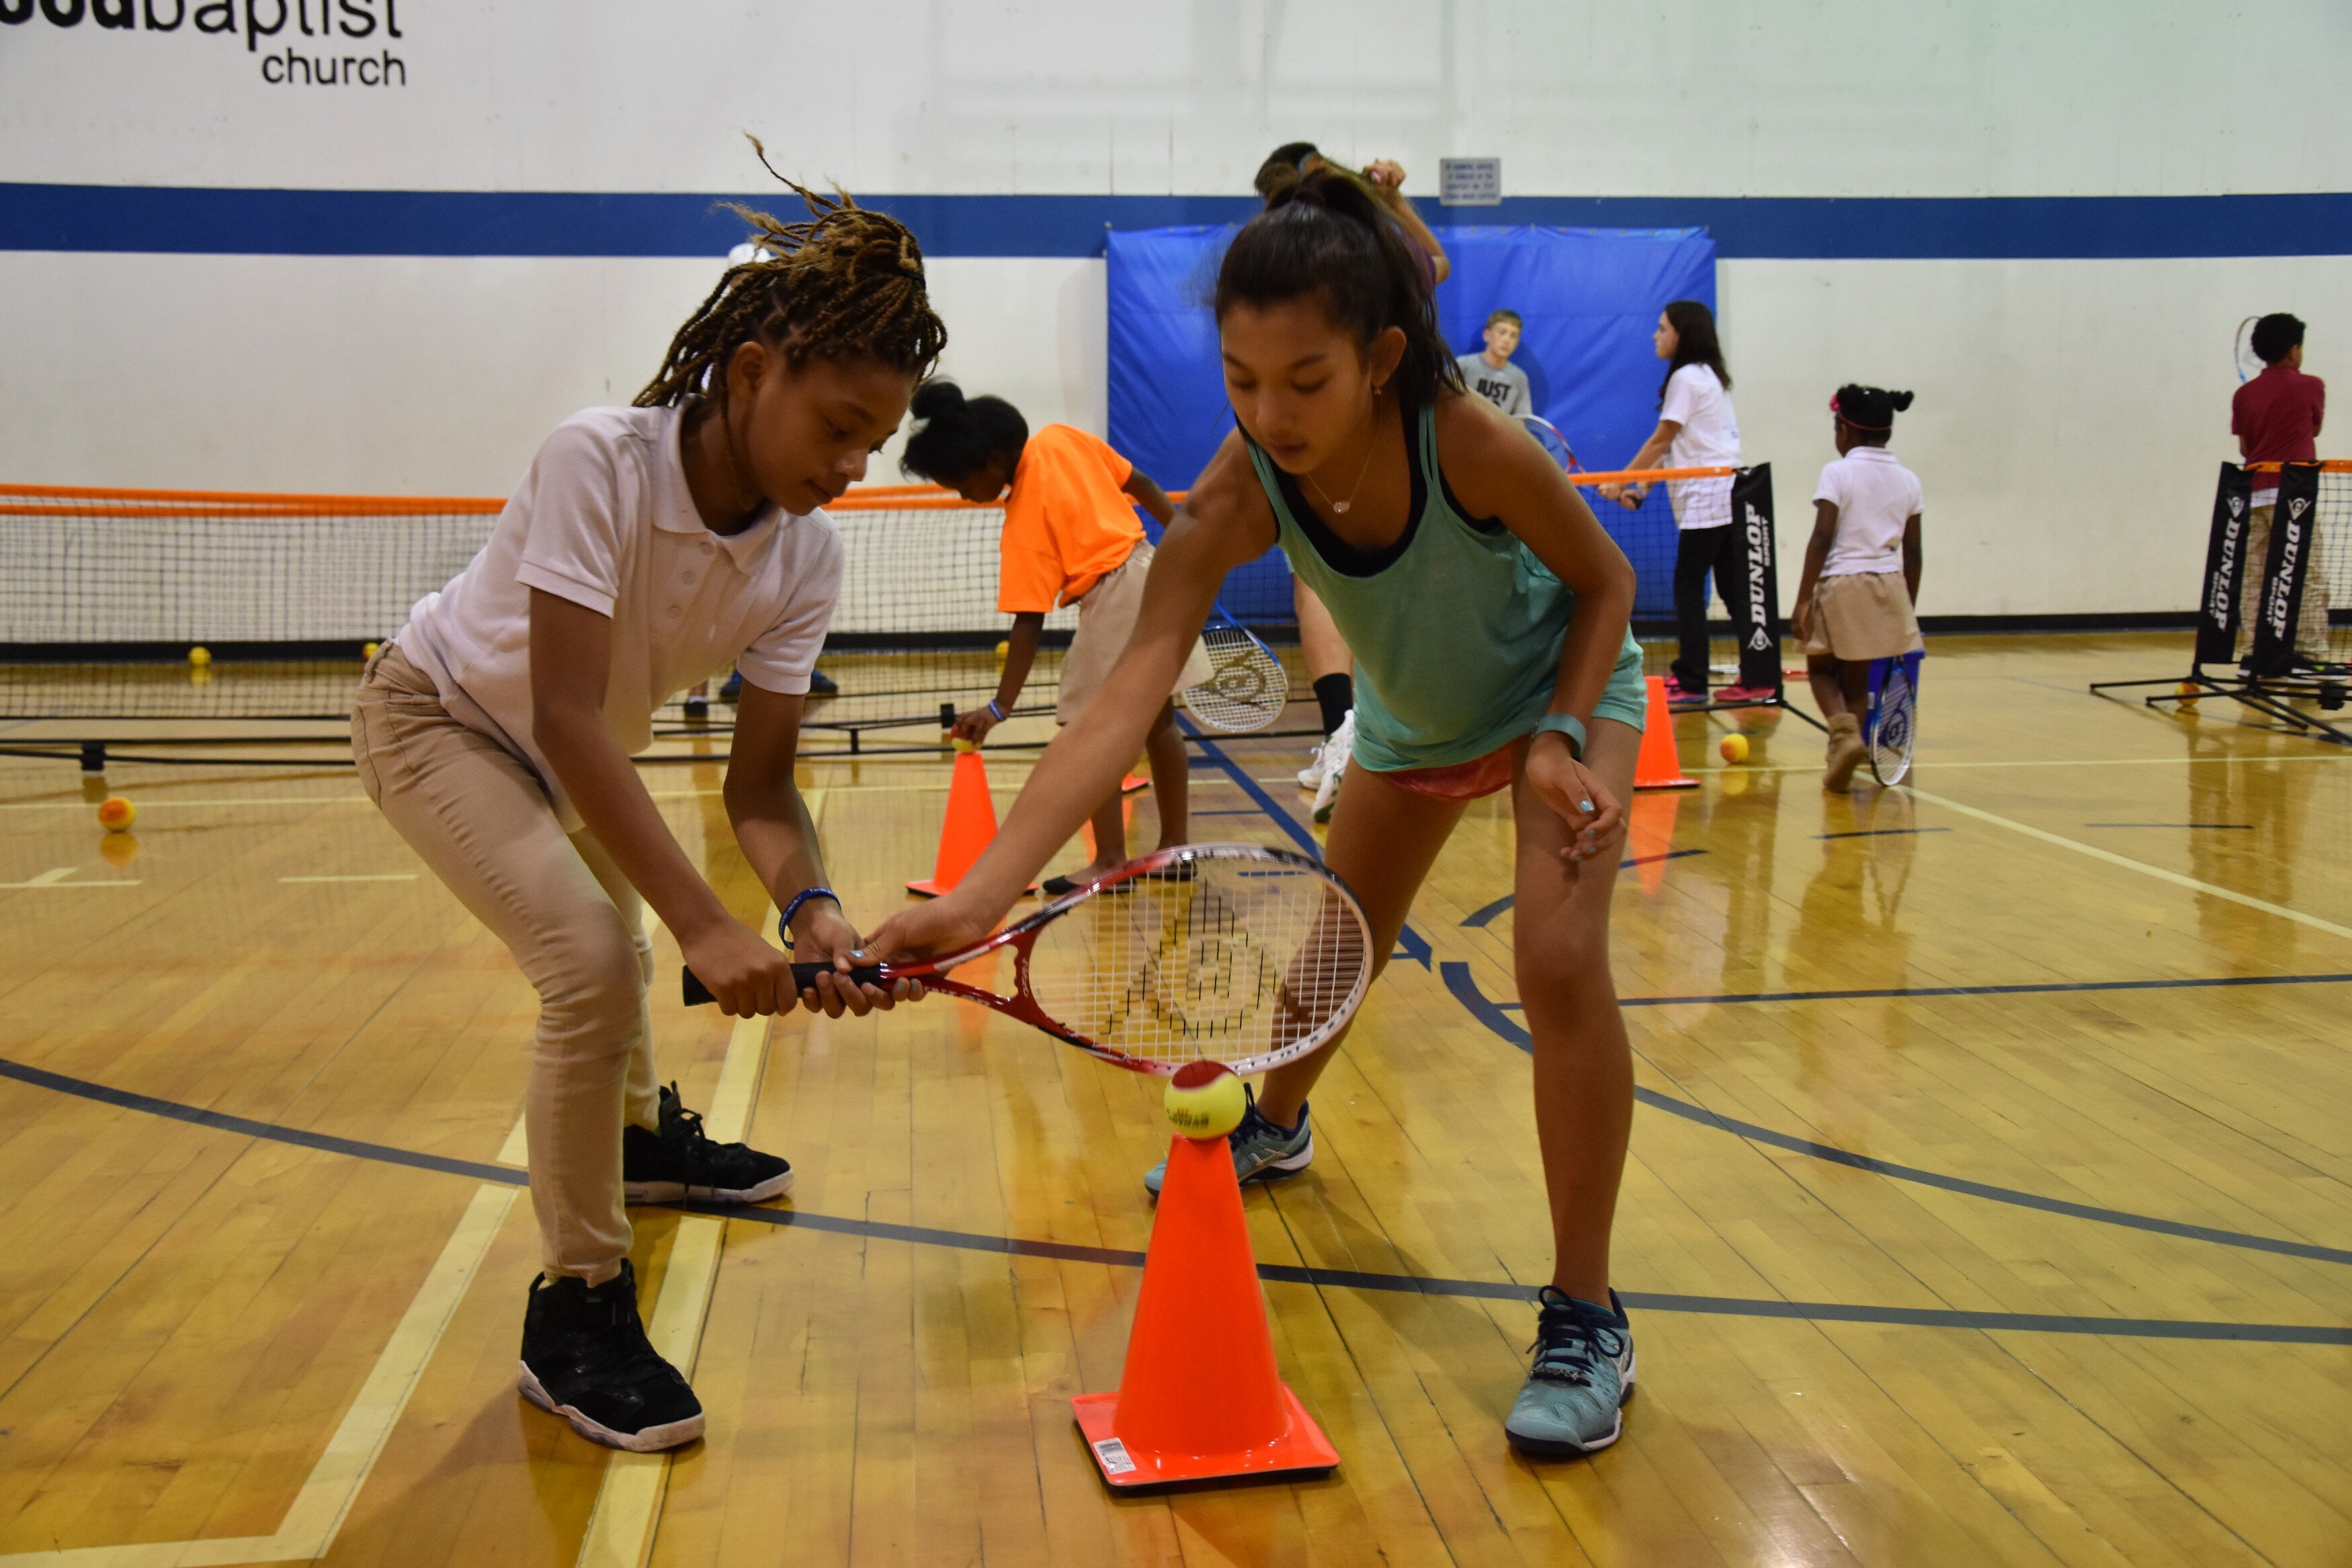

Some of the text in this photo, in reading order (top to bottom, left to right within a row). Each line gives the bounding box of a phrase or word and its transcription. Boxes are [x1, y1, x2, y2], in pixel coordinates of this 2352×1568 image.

[263, 47, 405, 85] church
[1745, 501, 1767, 626] DUNLOP
[1761, 515, 1771, 566] SPORT
[2215, 518, 2240, 631] DUNLOP
[2273, 519, 2301, 640] DUNLOP
[2267, 576, 2278, 625] SPORT
